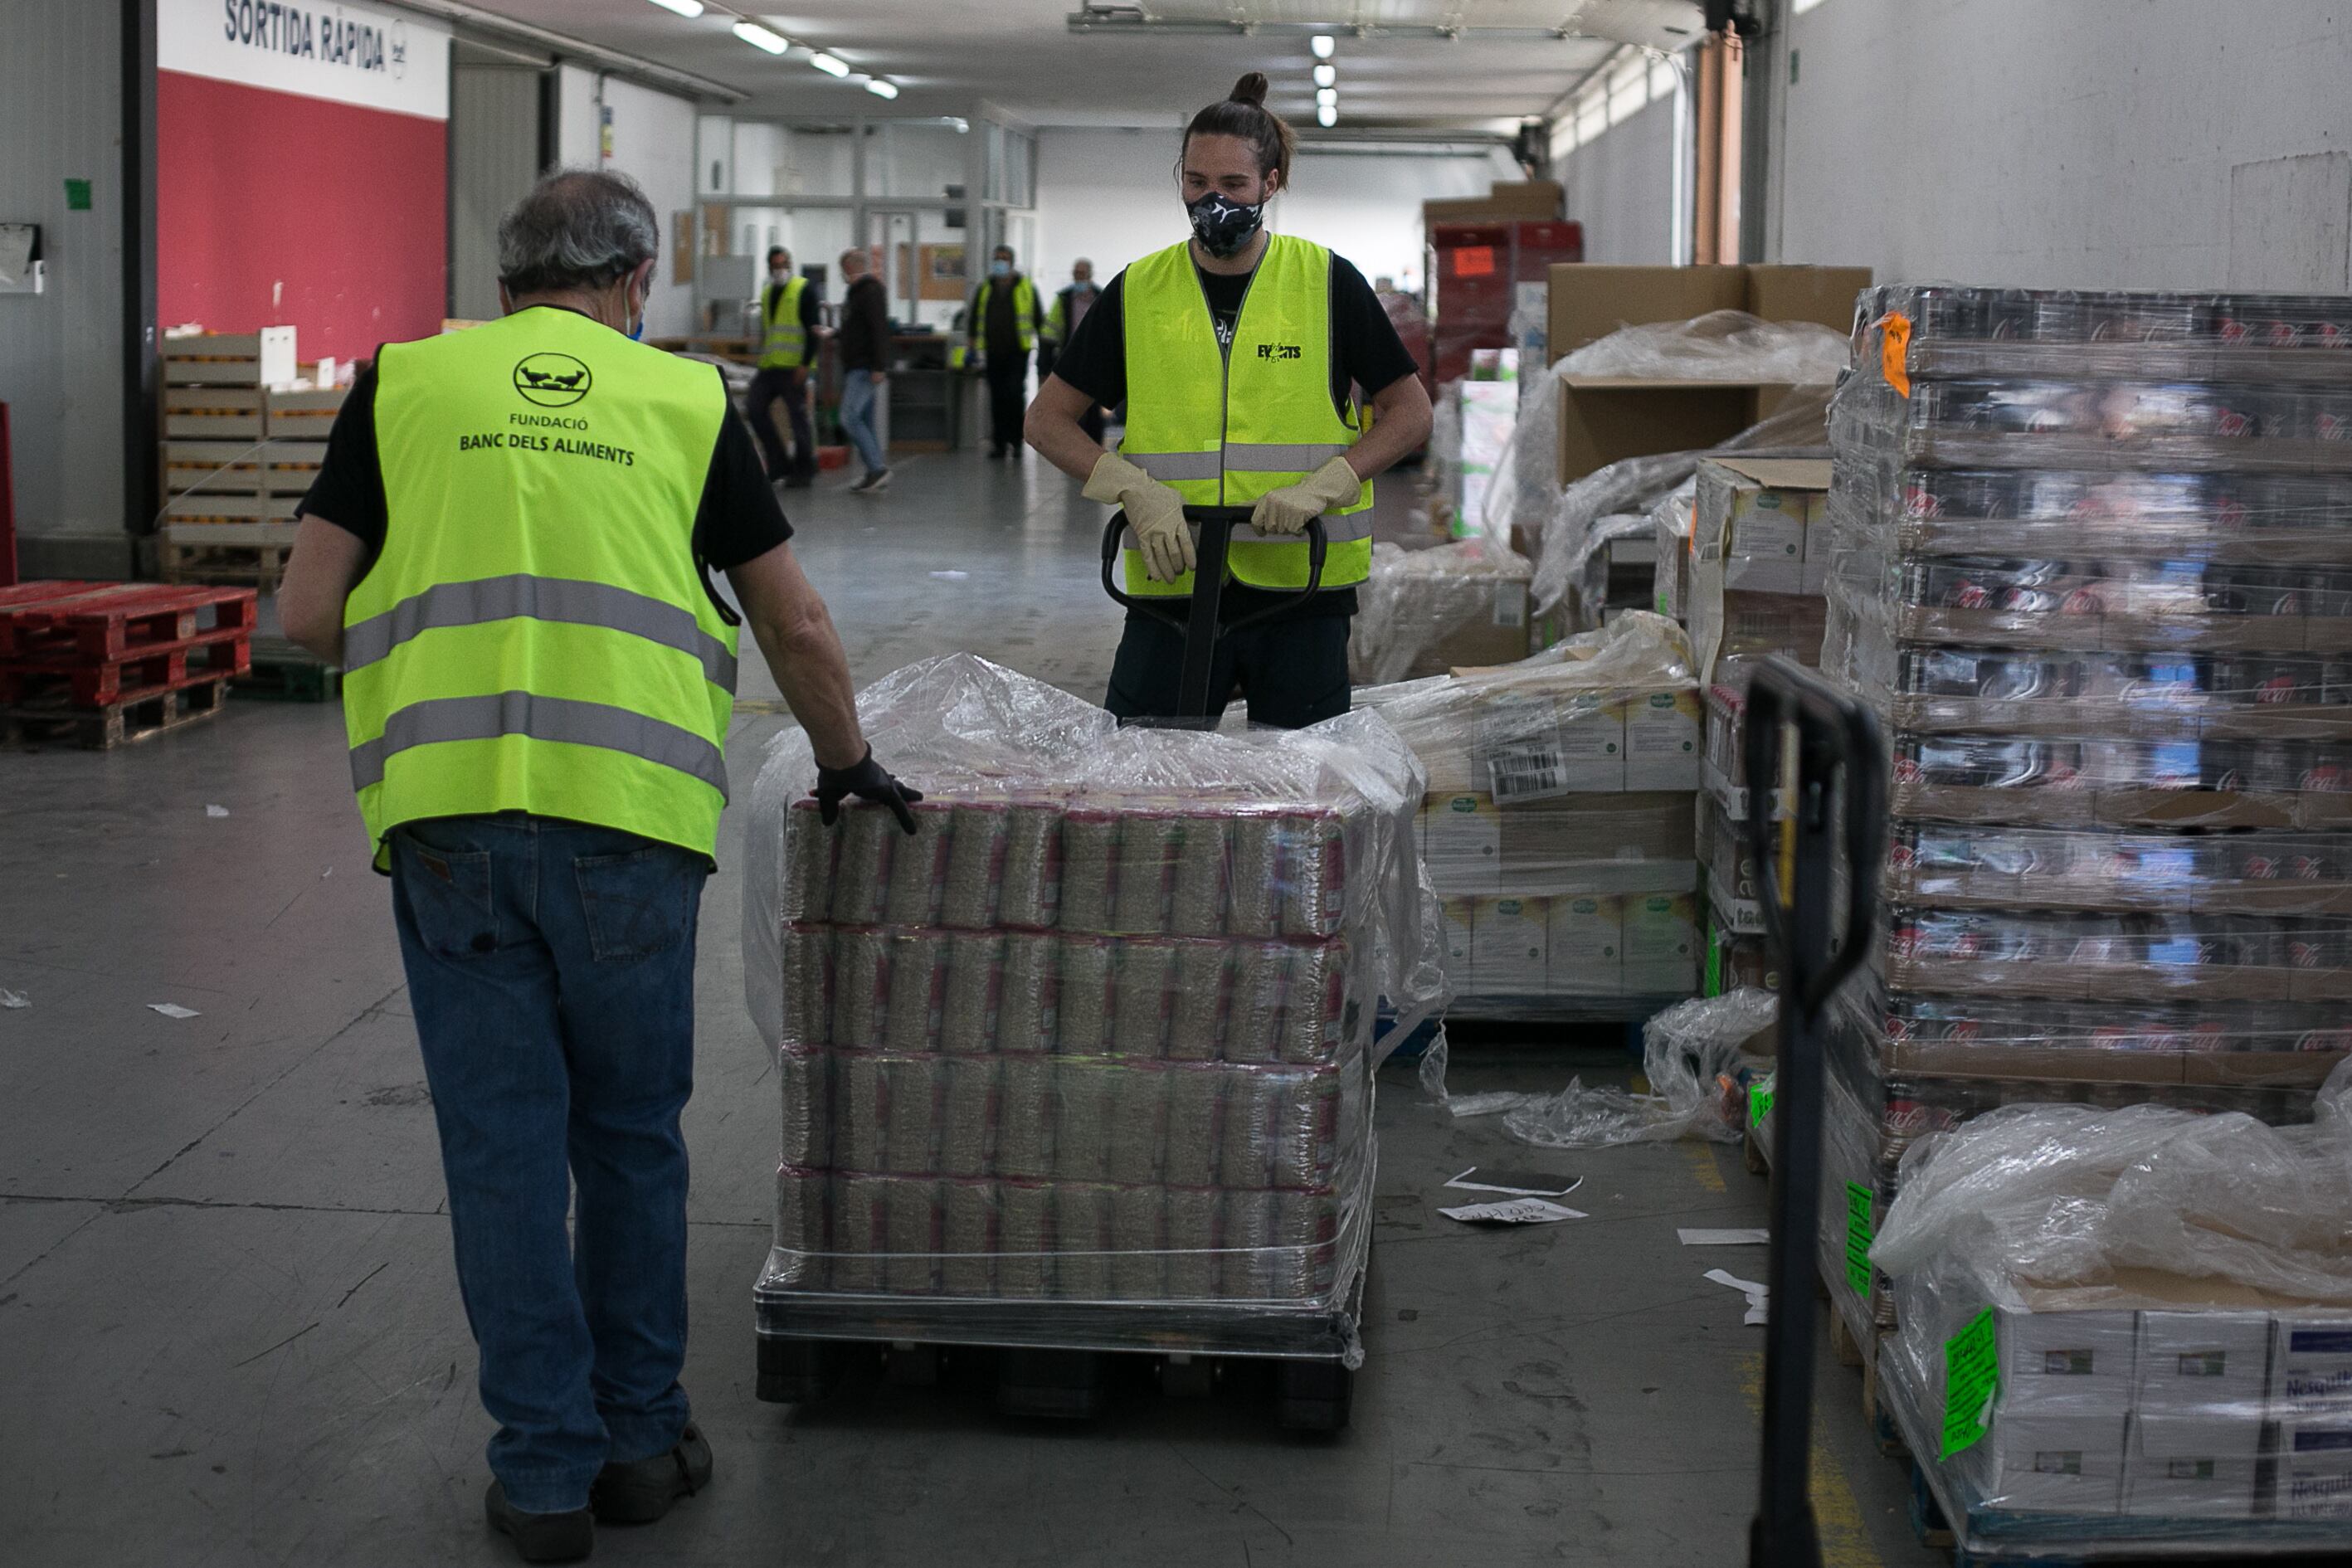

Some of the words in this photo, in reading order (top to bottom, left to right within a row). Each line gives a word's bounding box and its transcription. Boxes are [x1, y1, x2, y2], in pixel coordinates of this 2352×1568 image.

[226, 0, 314, 59] SORTIDA
[509, 413, 588, 431] FUNDACIÓ
[460, 433, 504, 451] BANC
[509, 434, 548, 452] DELS
[554, 437, 635, 466] ALIMENTS
